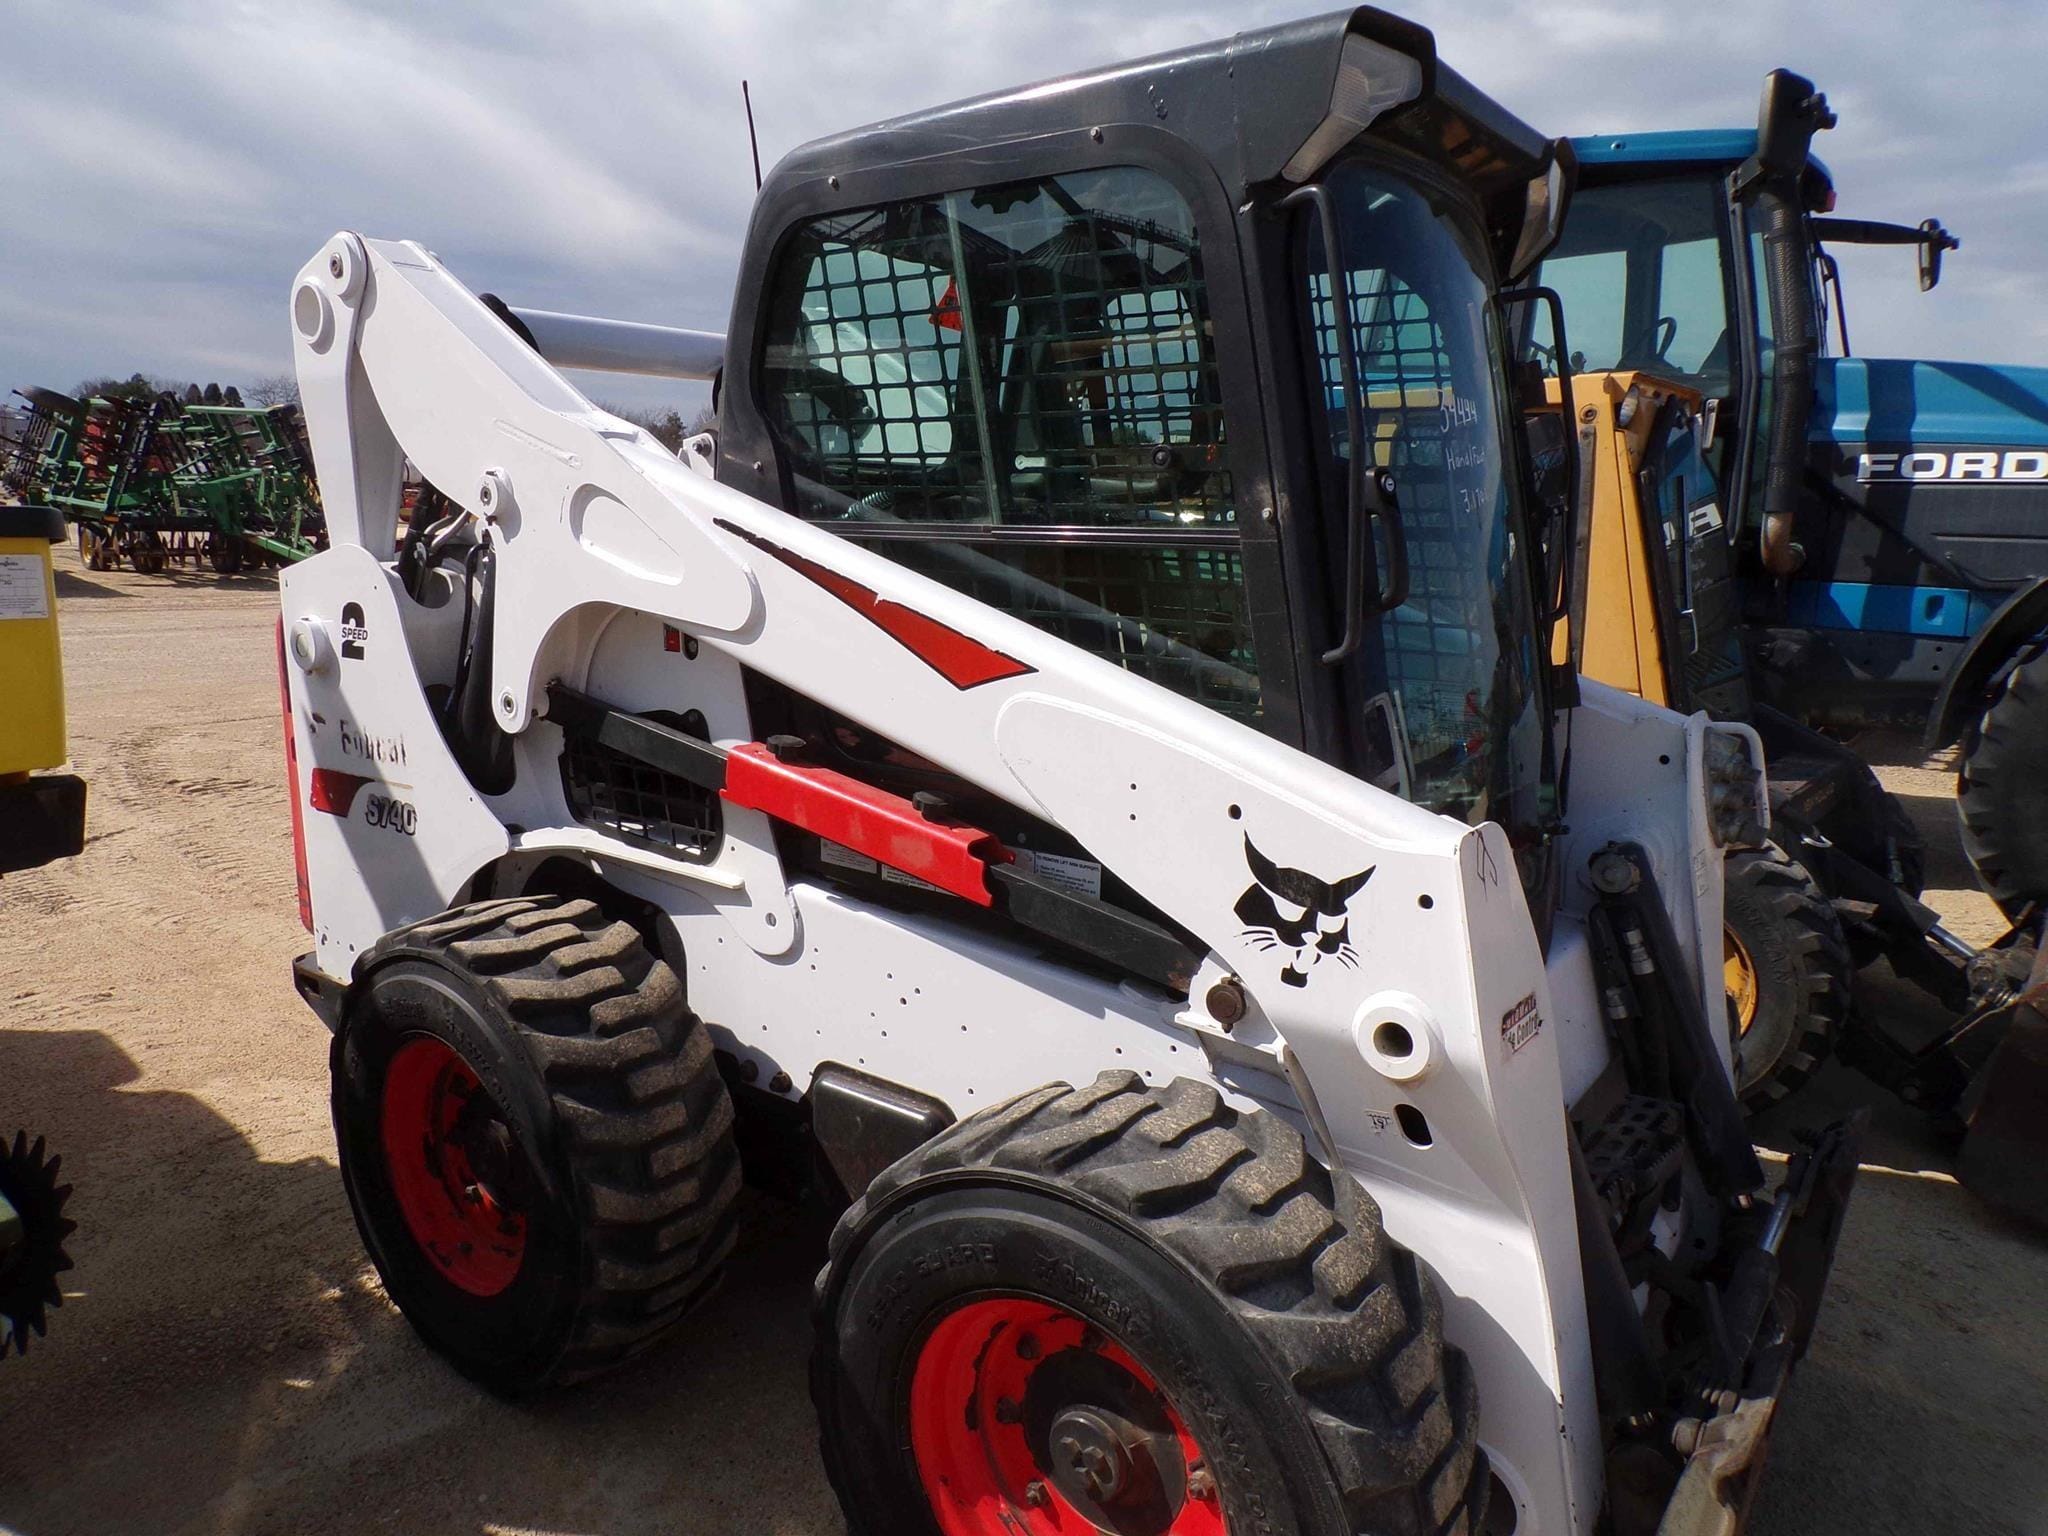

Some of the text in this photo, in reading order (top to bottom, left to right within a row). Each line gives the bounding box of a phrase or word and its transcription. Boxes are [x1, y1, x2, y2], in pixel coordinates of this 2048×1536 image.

[1857, 451, 2048, 479] FORD
[341, 601, 366, 660] 2
[341, 627, 369, 641] SPEED
[365, 793, 418, 836] S740
